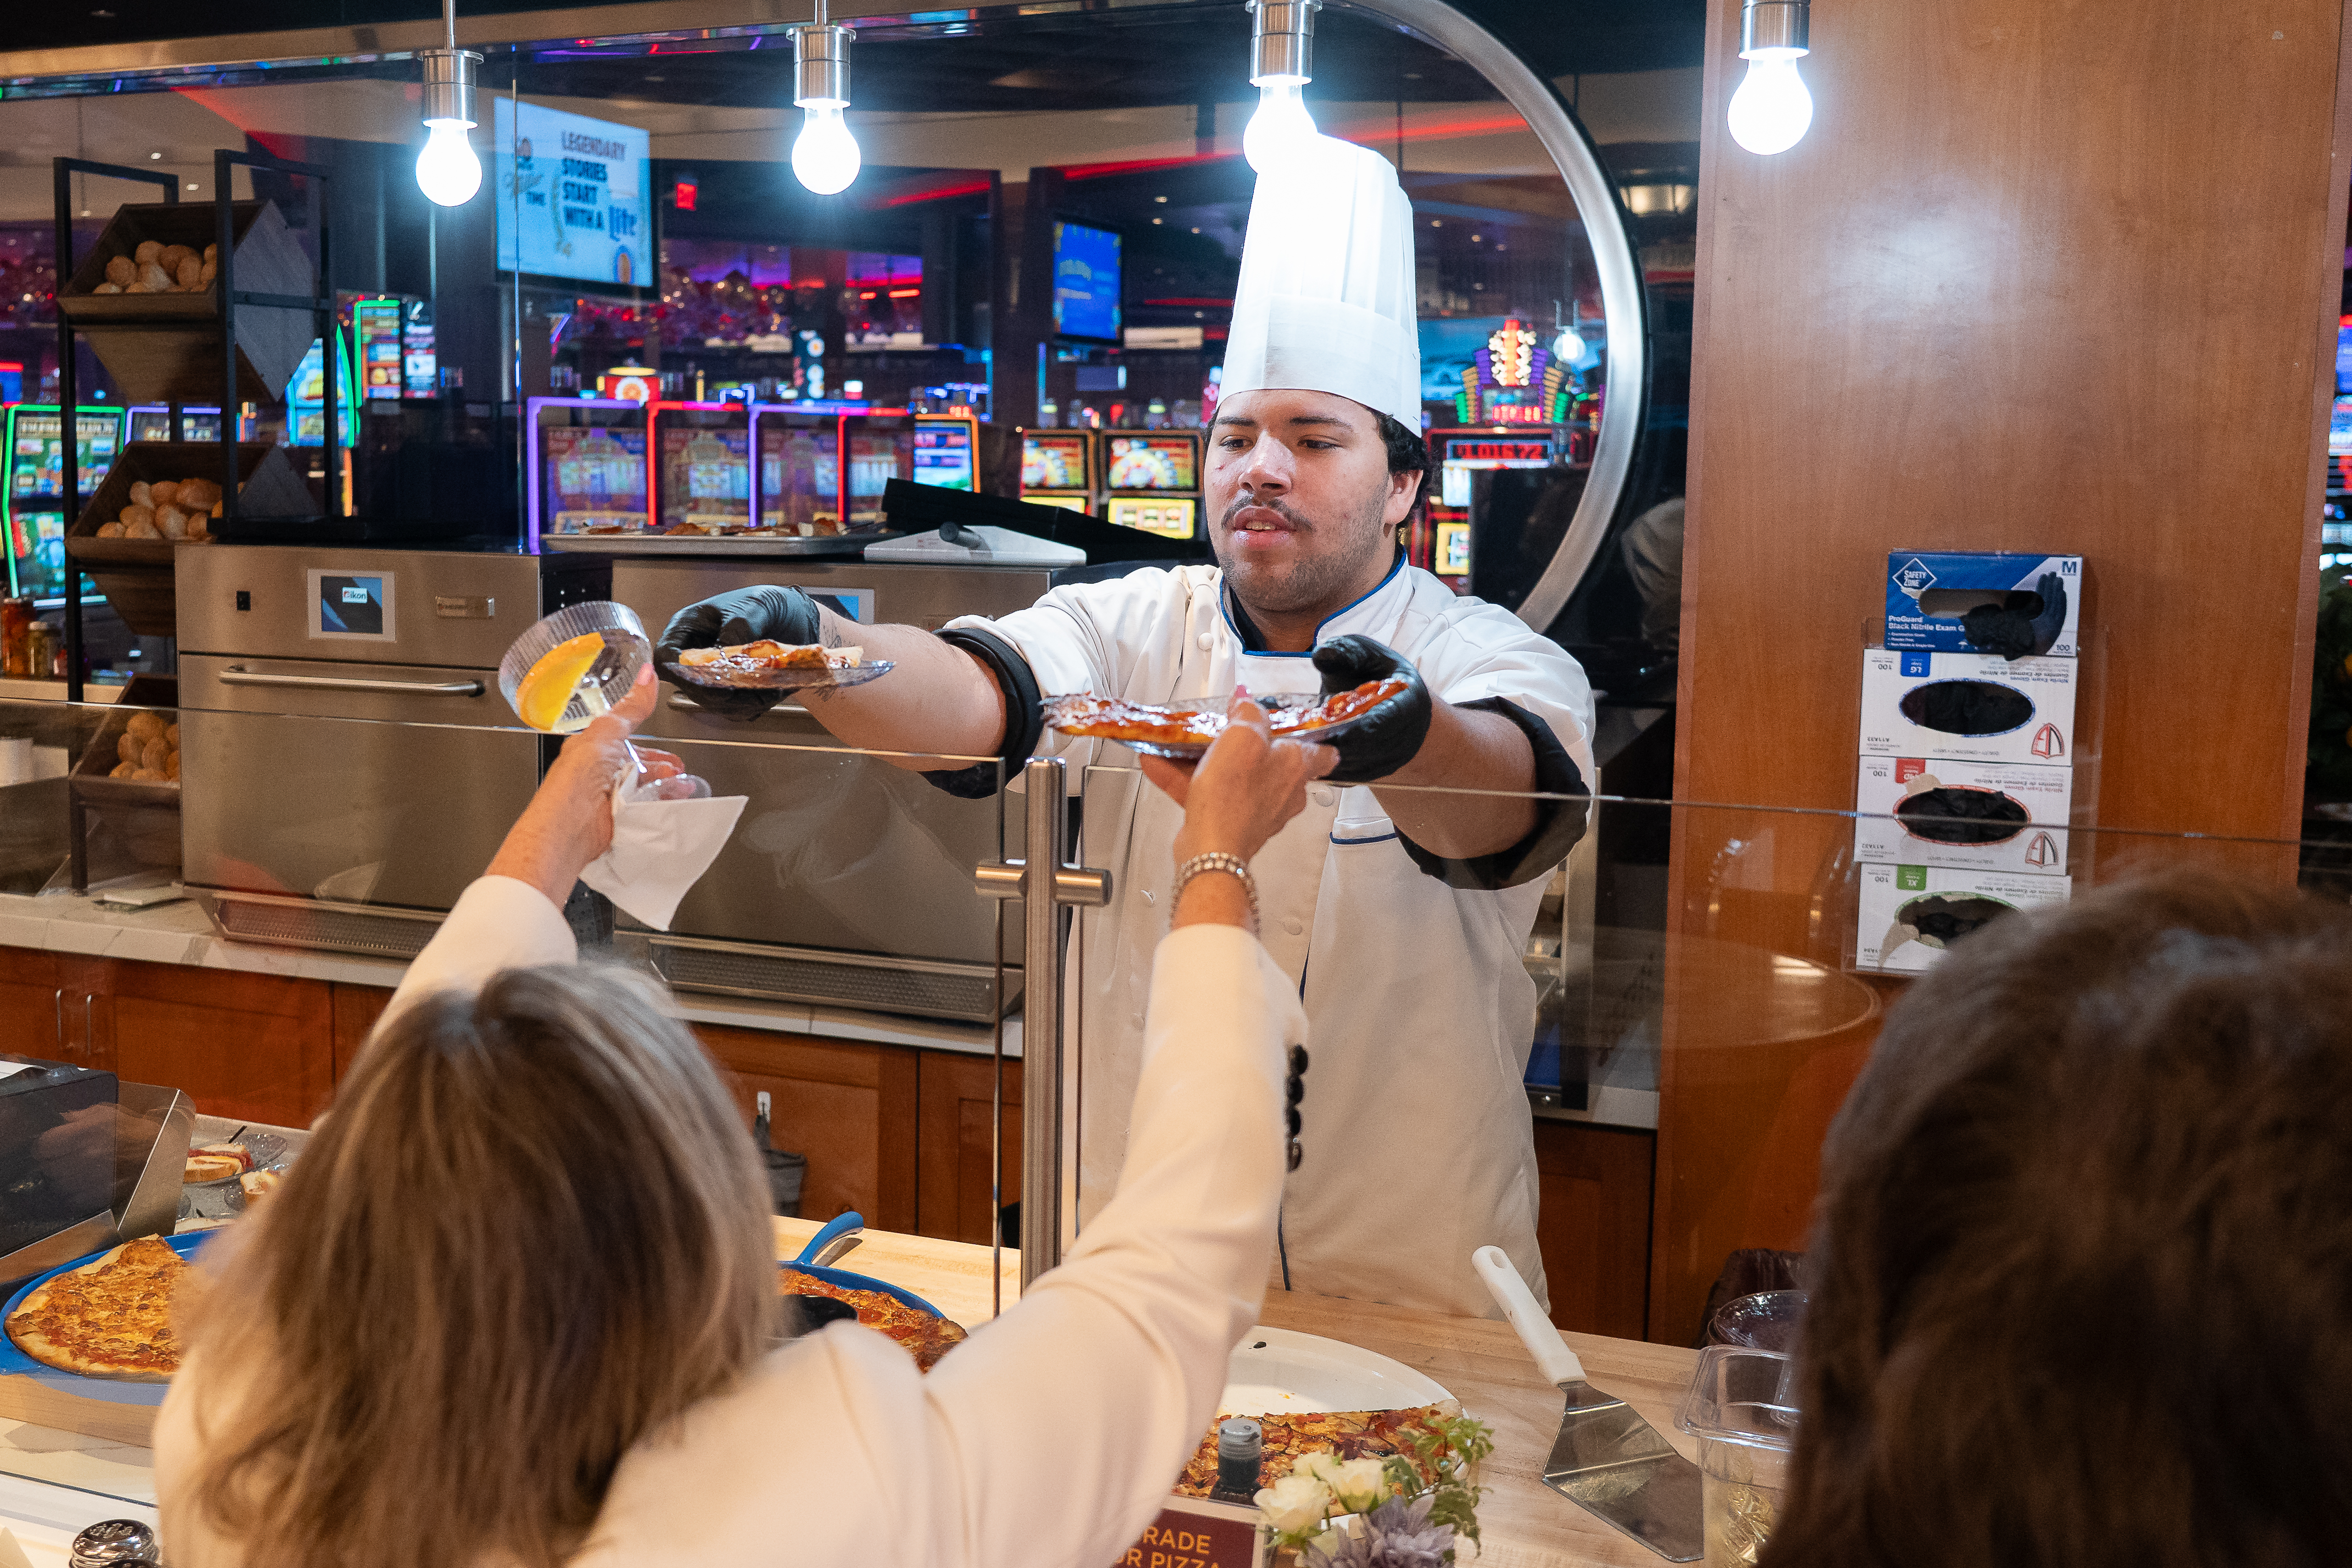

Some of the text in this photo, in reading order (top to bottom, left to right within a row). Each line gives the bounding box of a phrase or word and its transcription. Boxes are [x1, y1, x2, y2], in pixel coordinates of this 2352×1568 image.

[562, 132, 626, 160] LEGENDARY
[563, 158, 607, 181] STORIES
[563, 182, 597, 204] START
[596, 210, 604, 230] A
[1904, 570, 1927, 579] SAFETY
[2062, 561, 2076, 573] M
[1903, 579, 1919, 587] ZONE
[1142, 1525, 1212, 1555] RADE
